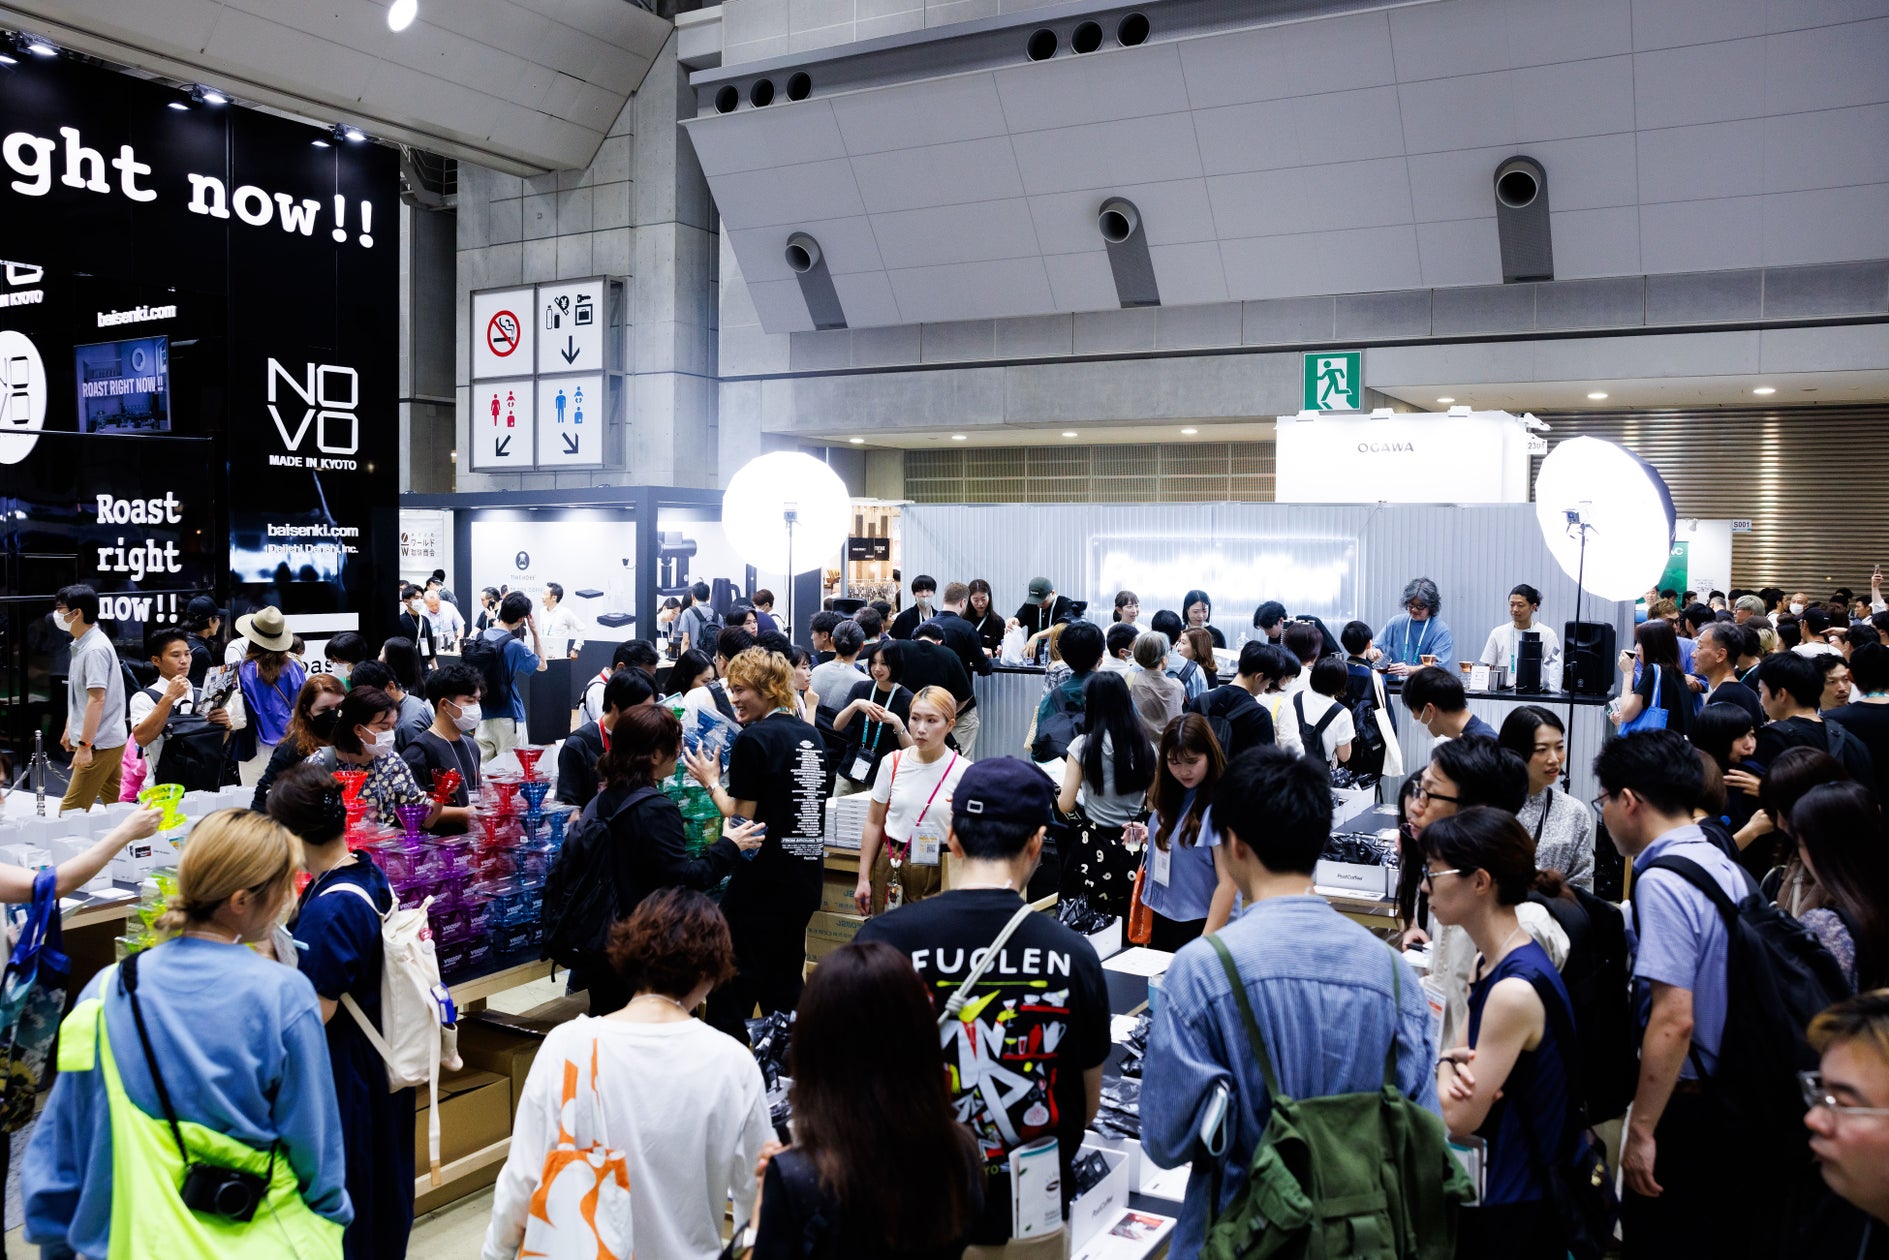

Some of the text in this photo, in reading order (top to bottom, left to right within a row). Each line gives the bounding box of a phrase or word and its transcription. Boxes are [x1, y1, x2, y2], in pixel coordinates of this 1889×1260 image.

[188, 173, 374, 248] now!!
[97, 305, 177, 327] baisenki.com
[82, 380, 109, 397] ROAST
[110, 378, 135, 395] RIGHT
[136, 376, 156, 393] NOW
[1357, 441, 1415, 453] OGAWA
[1527, 441, 1546, 450] 2301
[269, 455, 358, 471] MADE IN KYOTO
[96, 491, 182, 525] Roast
[267, 523, 359, 537] baisenki.com
[97, 537, 182, 582] right
[341, 544, 359, 554] Inc.
[98, 593, 178, 623] now!!
